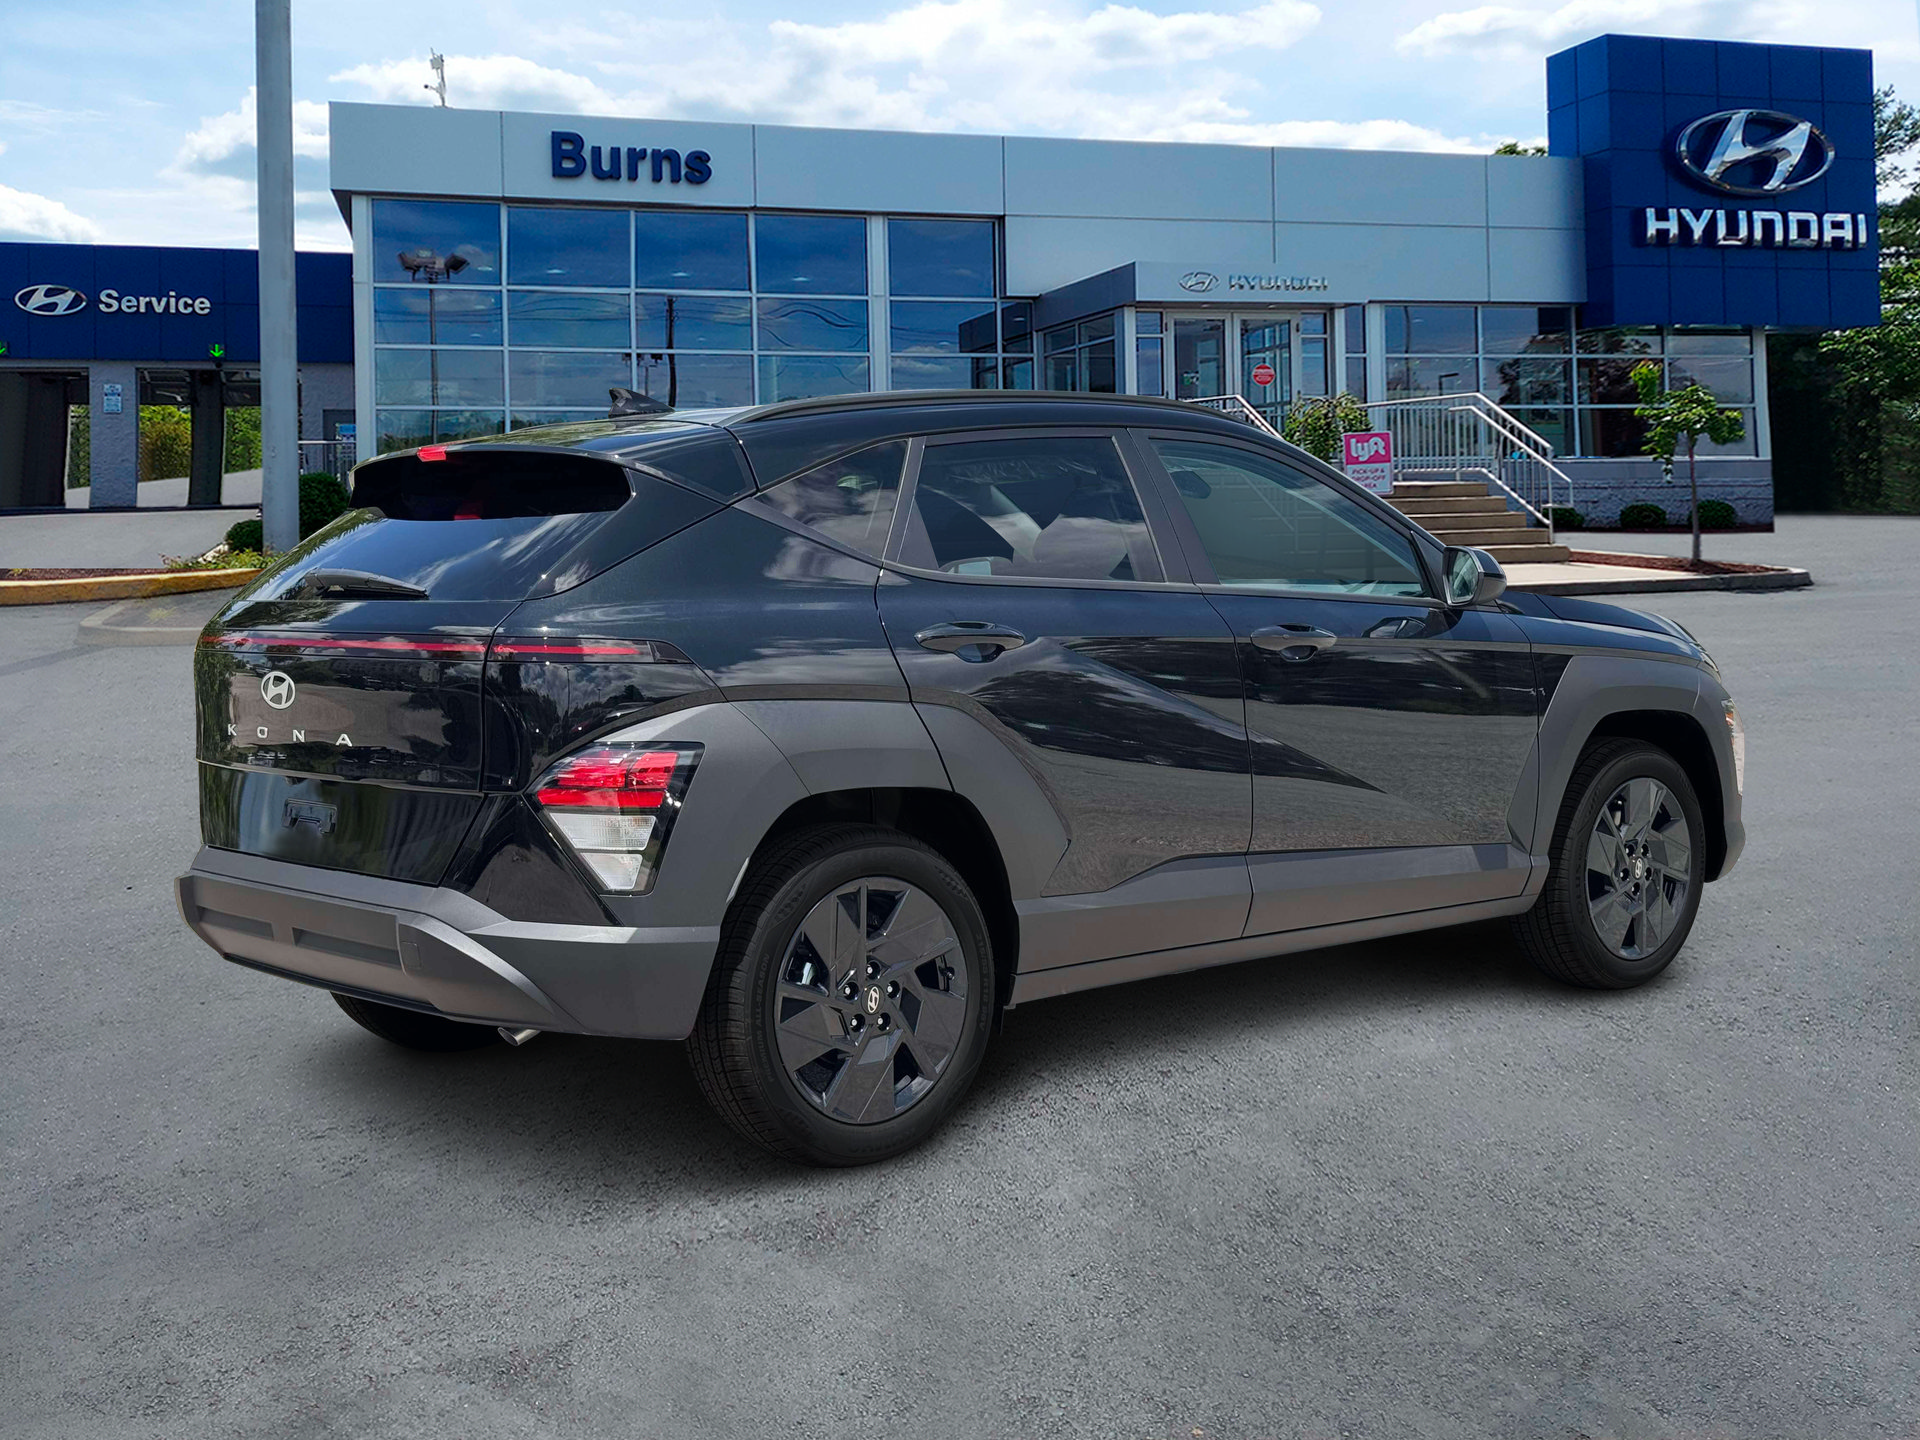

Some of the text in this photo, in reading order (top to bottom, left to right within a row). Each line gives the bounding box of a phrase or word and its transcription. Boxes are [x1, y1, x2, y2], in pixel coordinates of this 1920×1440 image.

[551, 130, 713, 185] Burns
[1645, 207, 1868, 248] HYUNDAI
[1228, 274, 1328, 291] HYUNDAI
[98, 288, 212, 315] Service
[1350, 436, 1386, 462] lyft
[227, 723, 353, 748] KONA
